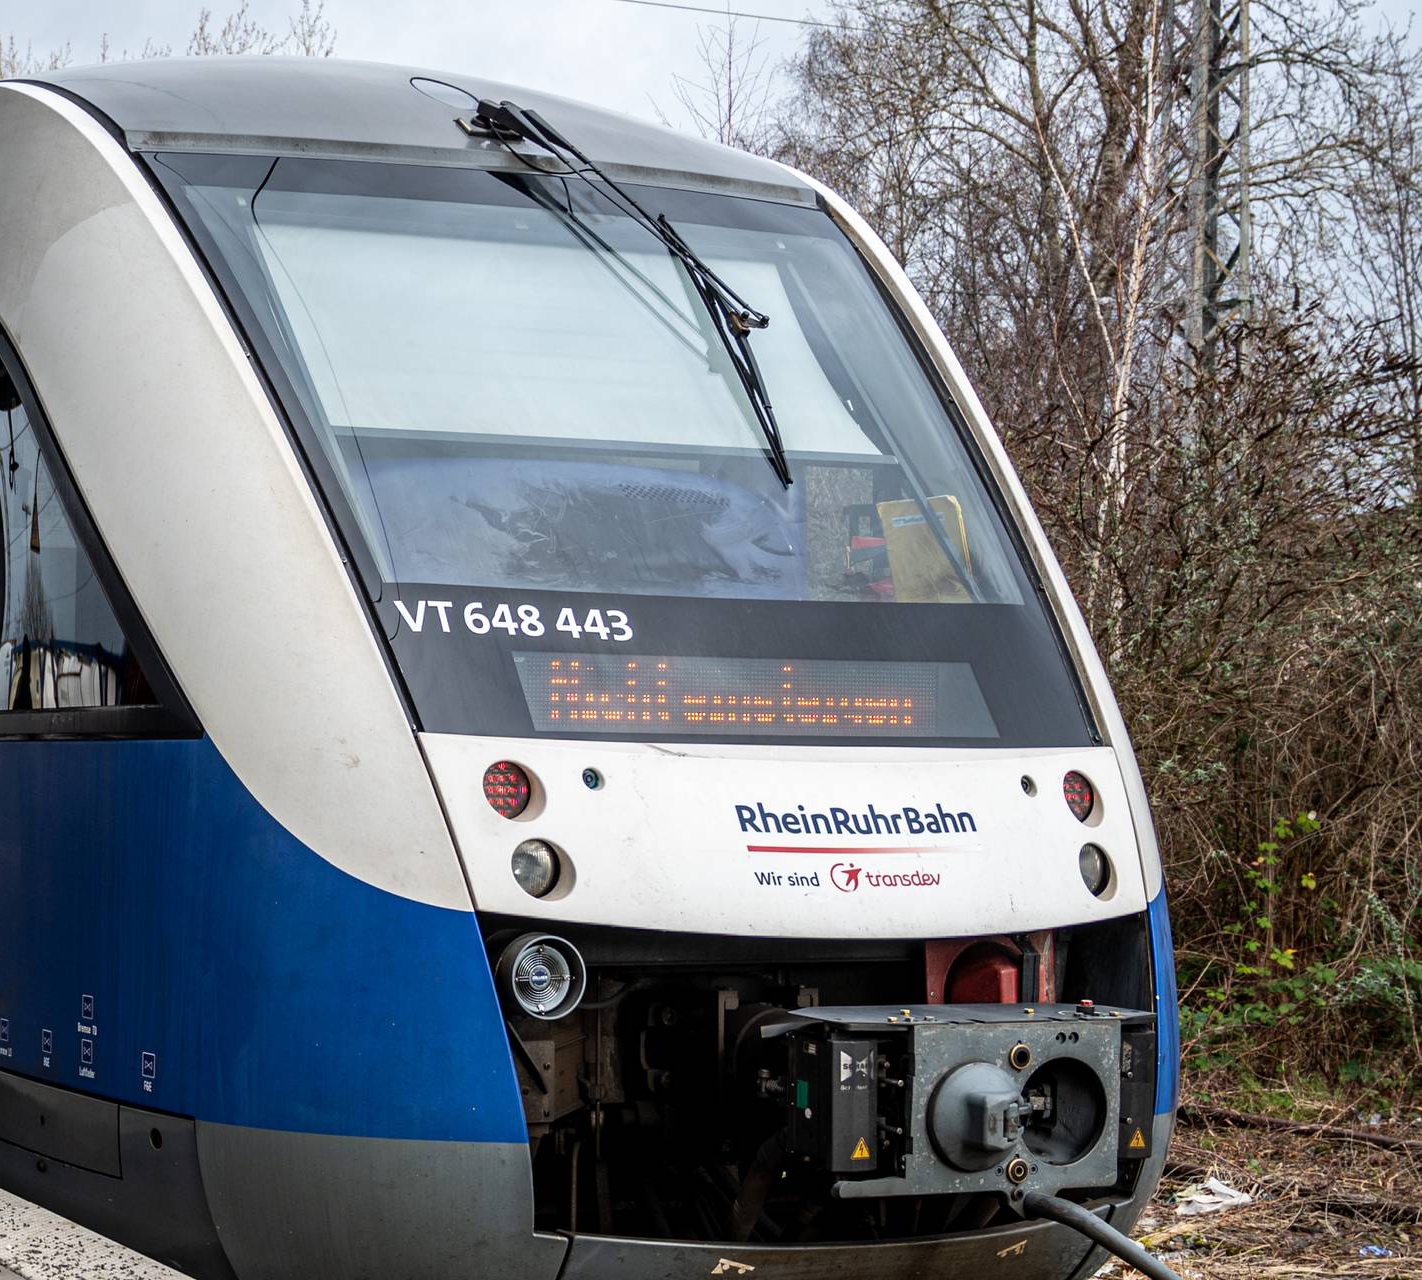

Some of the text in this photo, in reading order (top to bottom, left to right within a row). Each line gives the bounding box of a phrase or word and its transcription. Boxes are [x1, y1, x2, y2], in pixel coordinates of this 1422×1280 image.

[393, 599, 634, 641] VT 648 443
[734, 802, 978, 835] RheinRuhrBahn
[754, 871, 941, 887] Wir sind transdev
